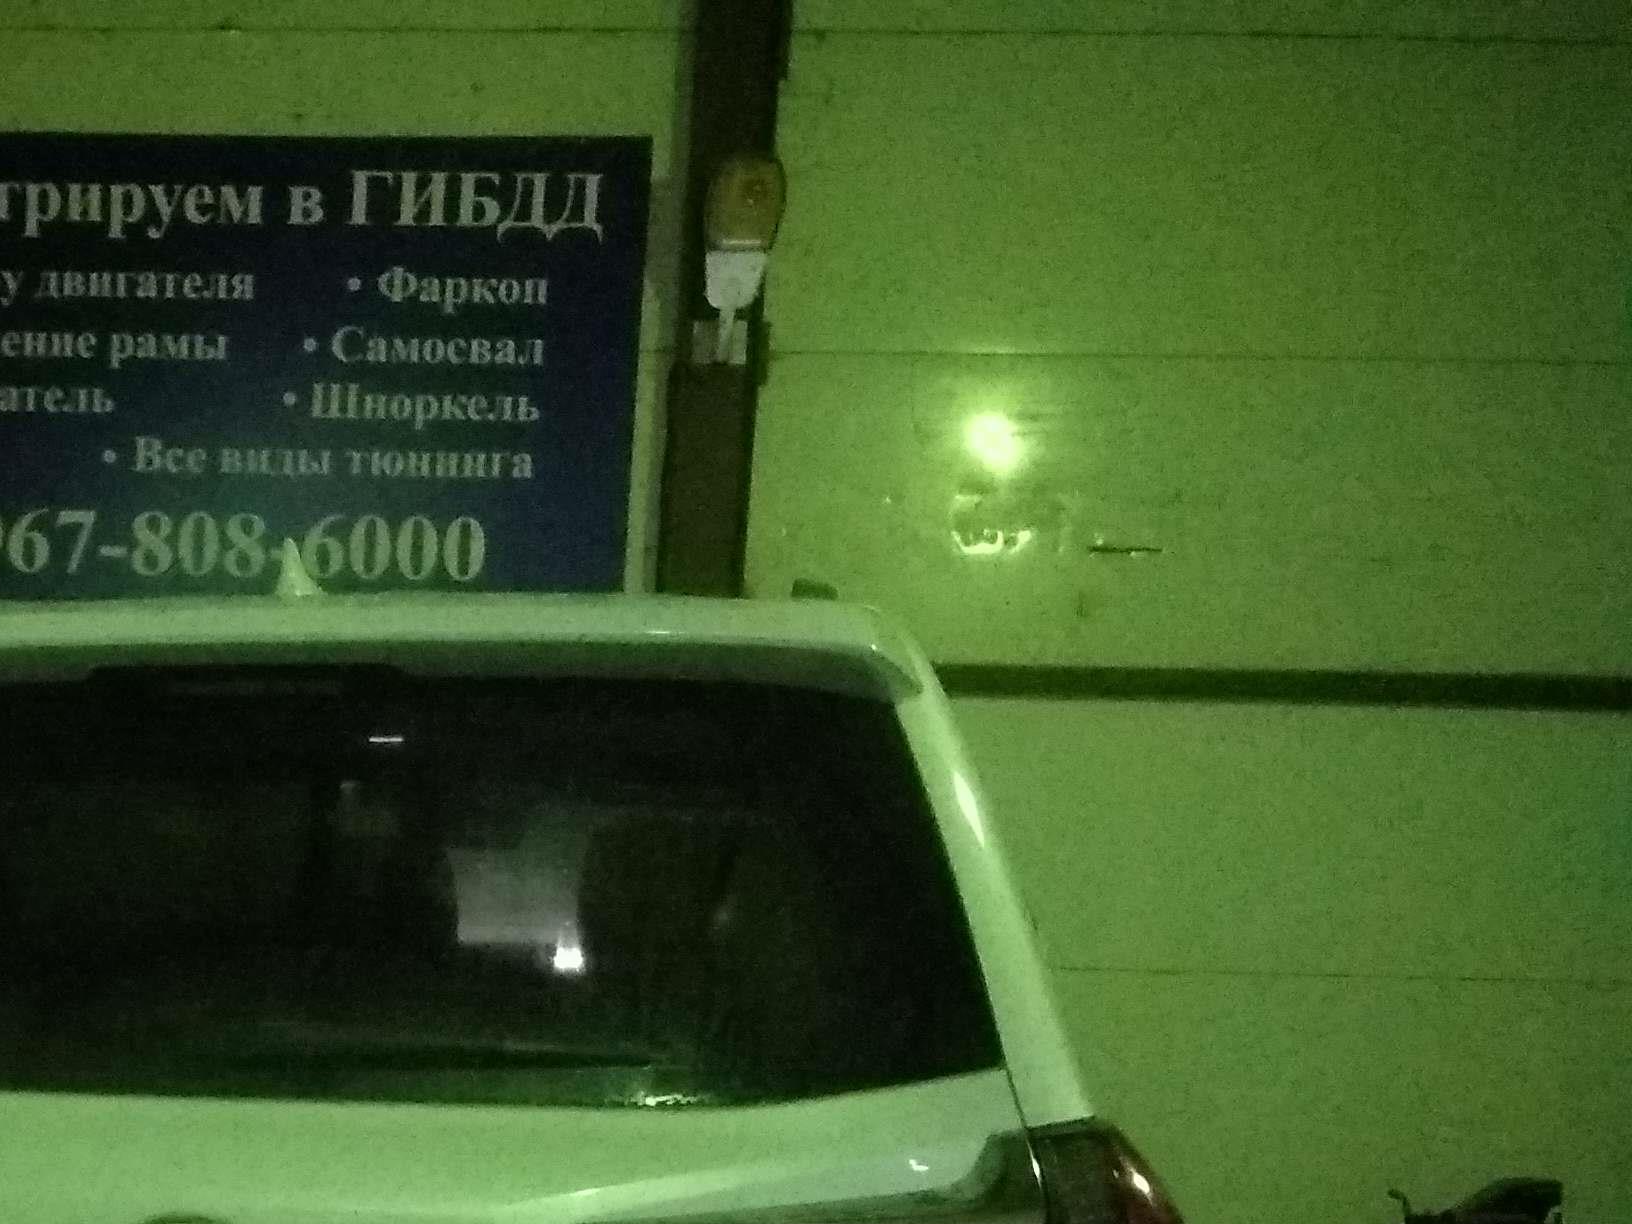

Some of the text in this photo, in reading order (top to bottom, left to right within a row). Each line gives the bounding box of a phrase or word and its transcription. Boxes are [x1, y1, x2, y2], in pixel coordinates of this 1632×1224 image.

[288, 185, 325, 225] в
[346, 169, 604, 245] ГИБДД
[34, 267, 256, 301] двигателя
[377, 266, 549, 314] Фаркоп
[109, 330, 229, 368] рамы
[331, 325, 545, 367] Самосвал
[311, 381, 540, 431] Шноркель
[132, 435, 535, 480] Все виды тюнинга
